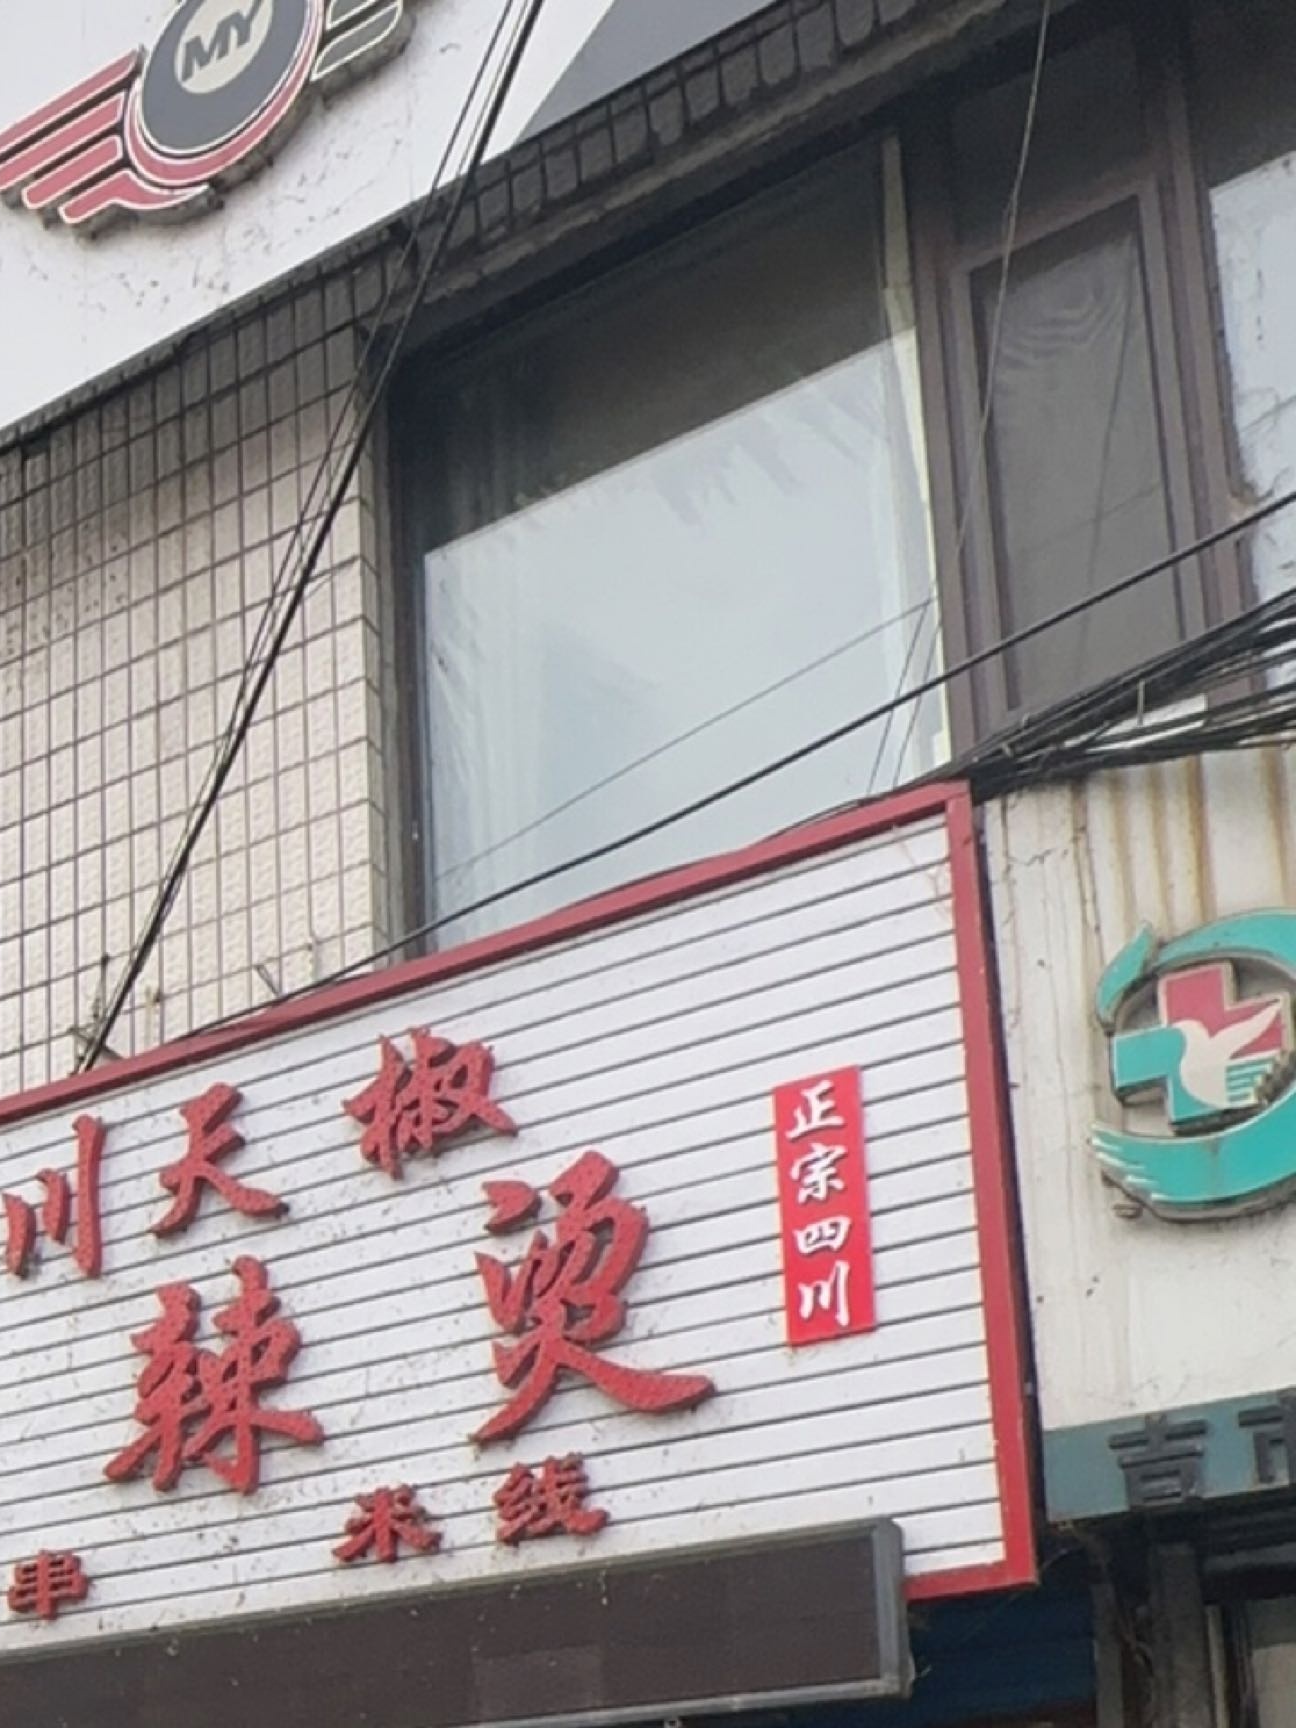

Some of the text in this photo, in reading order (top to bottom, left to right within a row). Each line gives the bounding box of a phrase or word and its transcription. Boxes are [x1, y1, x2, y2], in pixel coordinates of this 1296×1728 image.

[785, 1079, 850, 1327] 正宗四川
[332, 1452, 610, 1564] 米线
